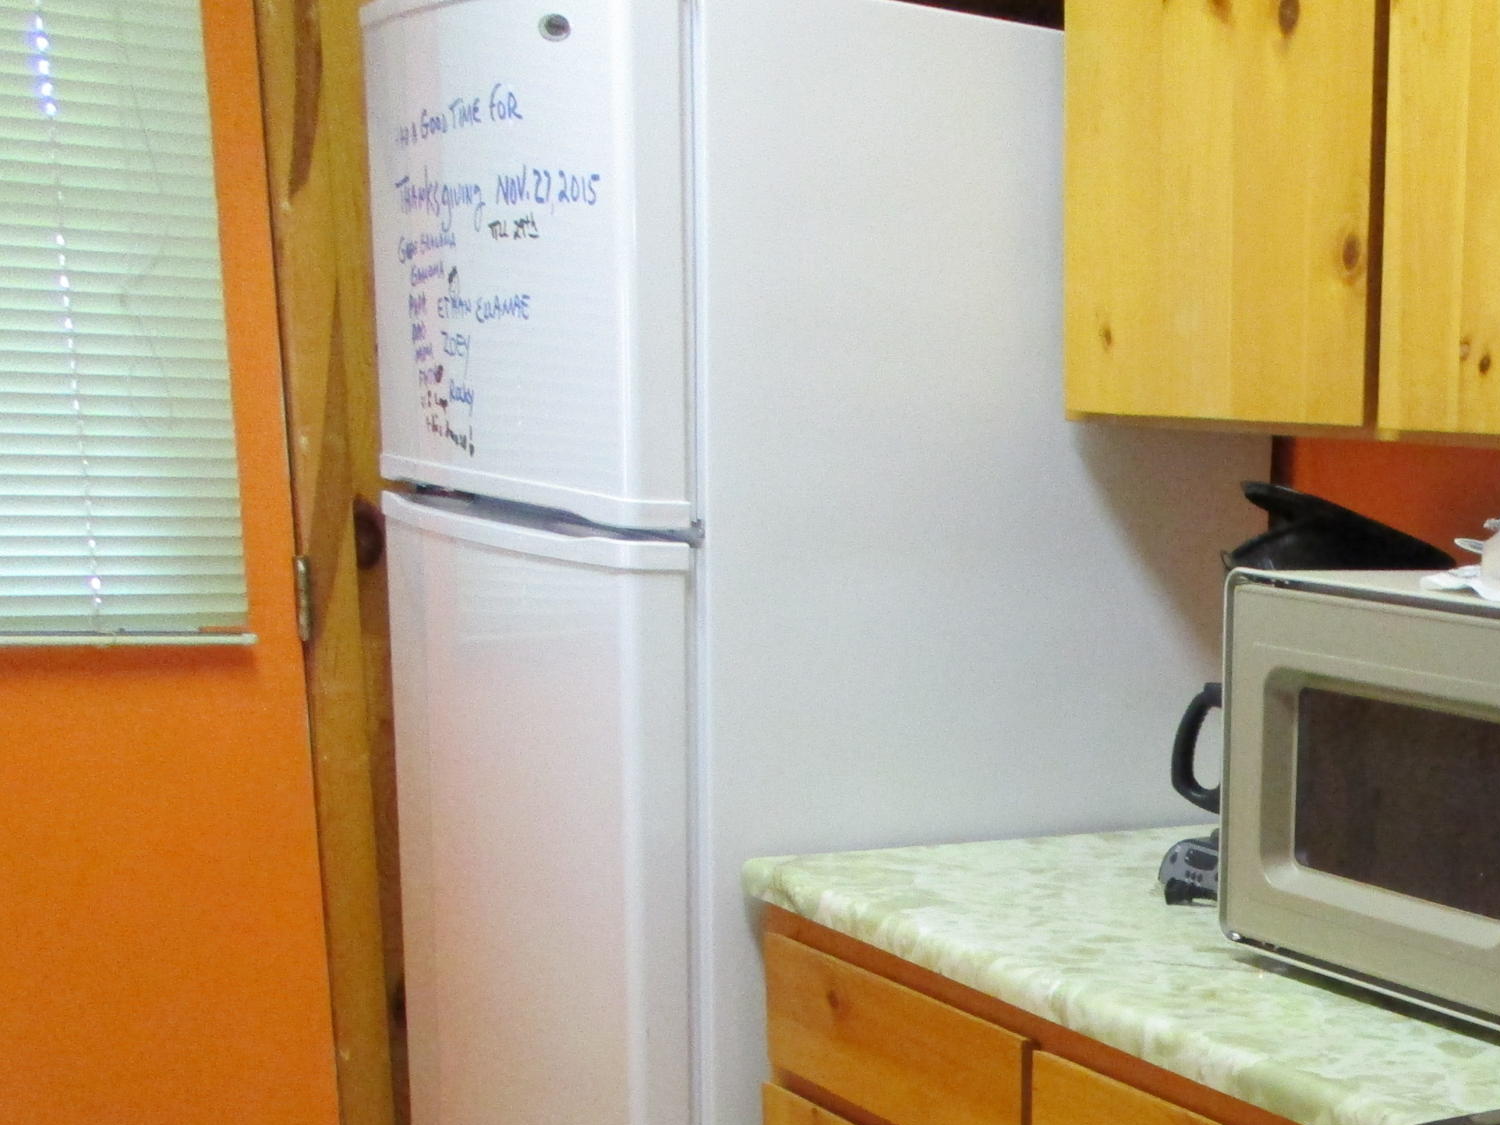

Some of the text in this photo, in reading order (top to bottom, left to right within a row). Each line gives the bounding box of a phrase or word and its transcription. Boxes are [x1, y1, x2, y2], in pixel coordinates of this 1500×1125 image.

[448, 97, 481, 129] TIME
[489, 82, 523, 121] FOR
[557, 169, 601, 206] 2015
